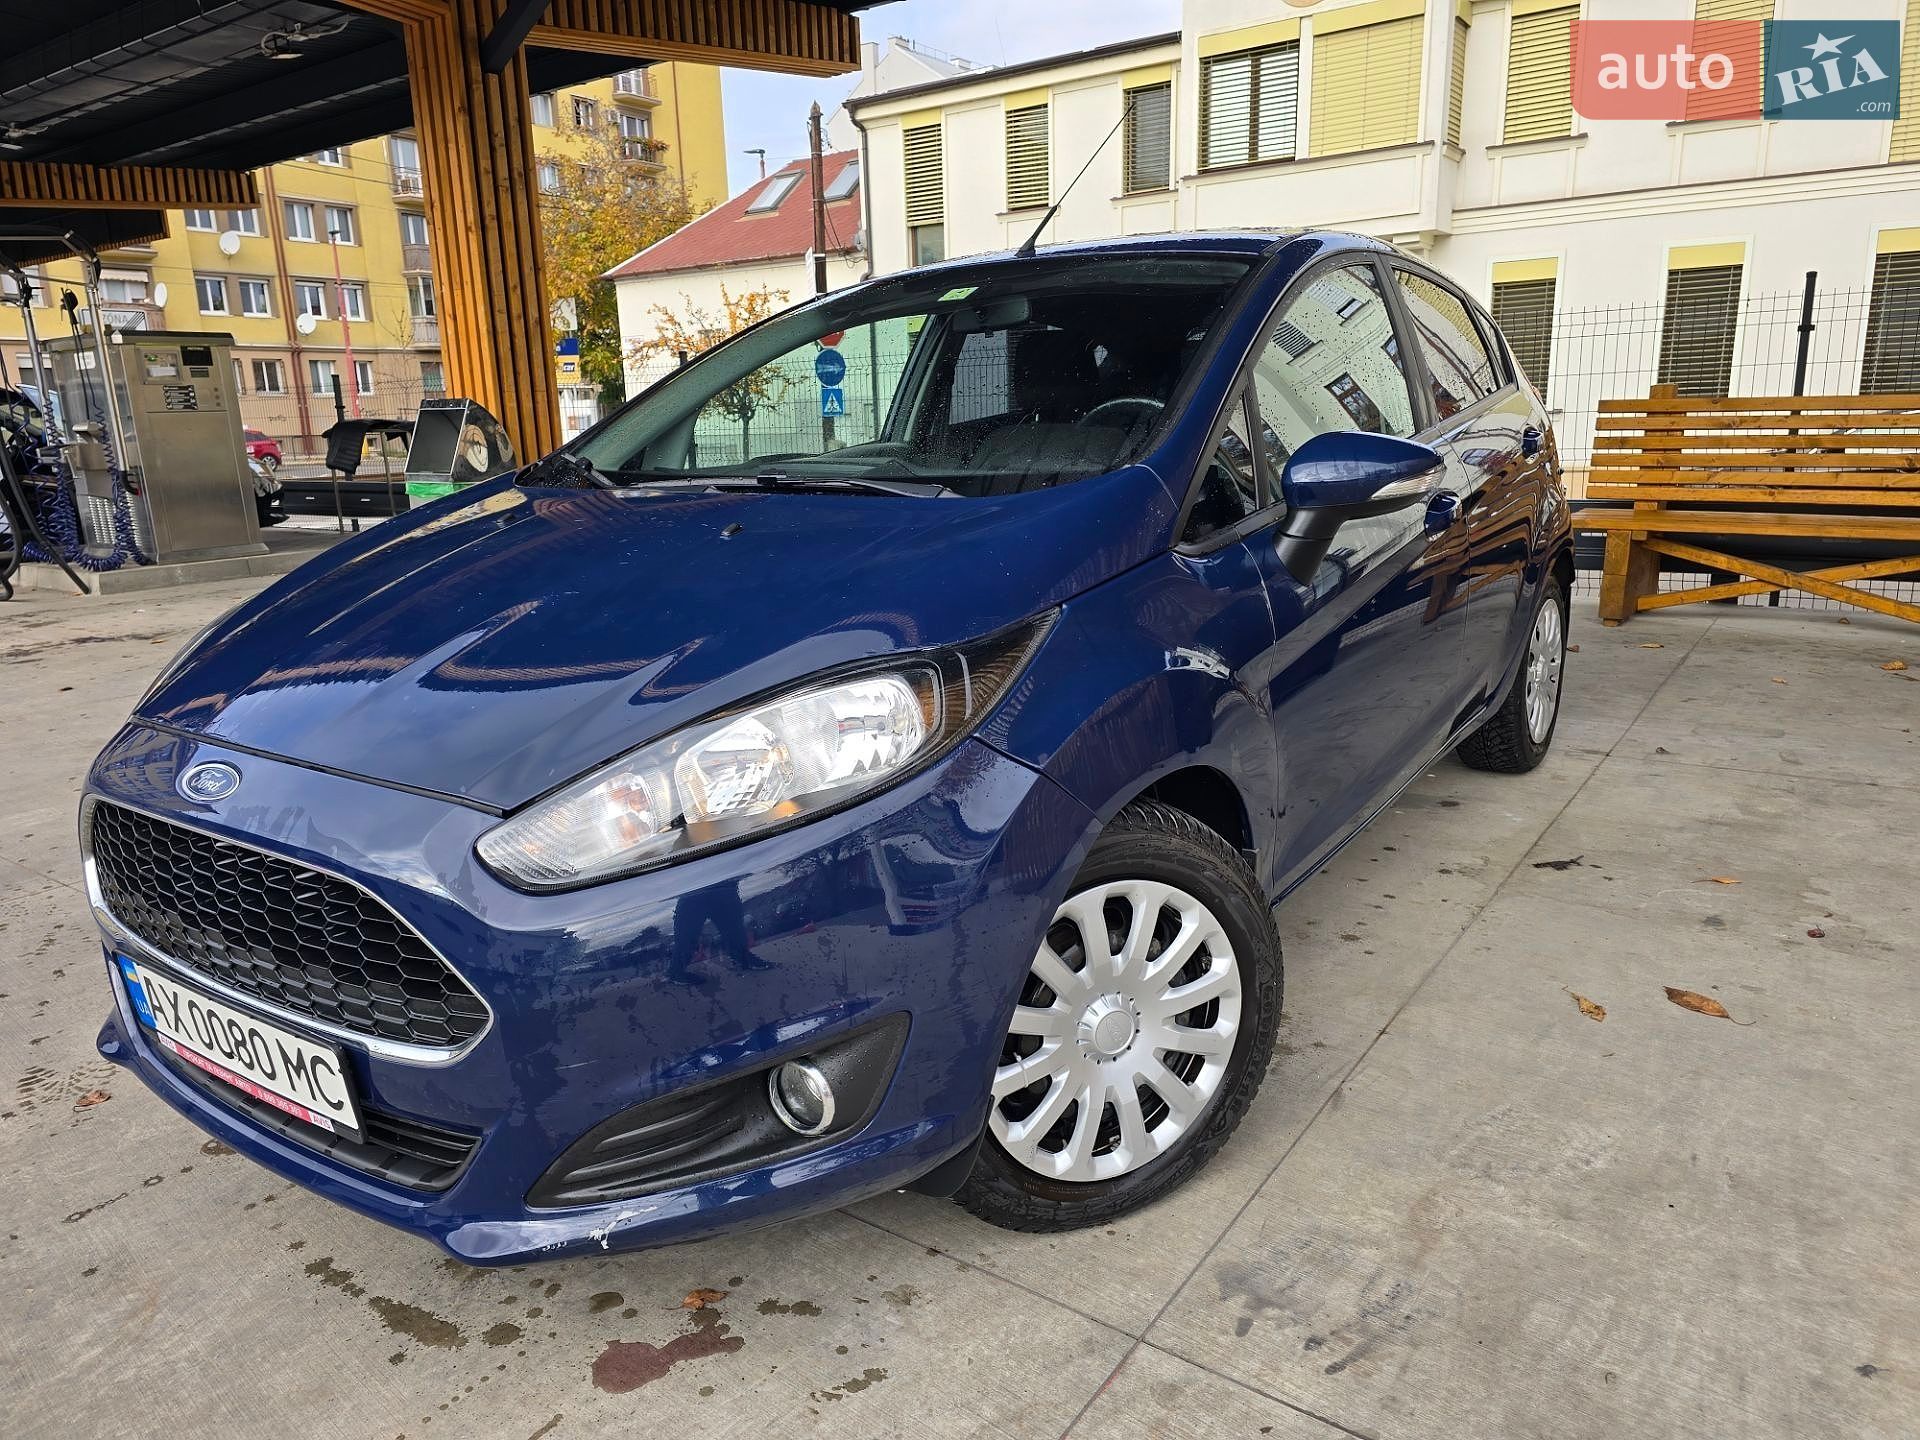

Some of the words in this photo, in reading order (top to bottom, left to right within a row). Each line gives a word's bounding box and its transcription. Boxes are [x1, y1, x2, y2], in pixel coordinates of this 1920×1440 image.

[191, 770, 226, 791] Ford
[136, 998, 152, 1016] UA
[143, 975, 194, 1041] AX
[188, 1000, 277, 1080] 0080
[276, 1038, 344, 1111] MC
